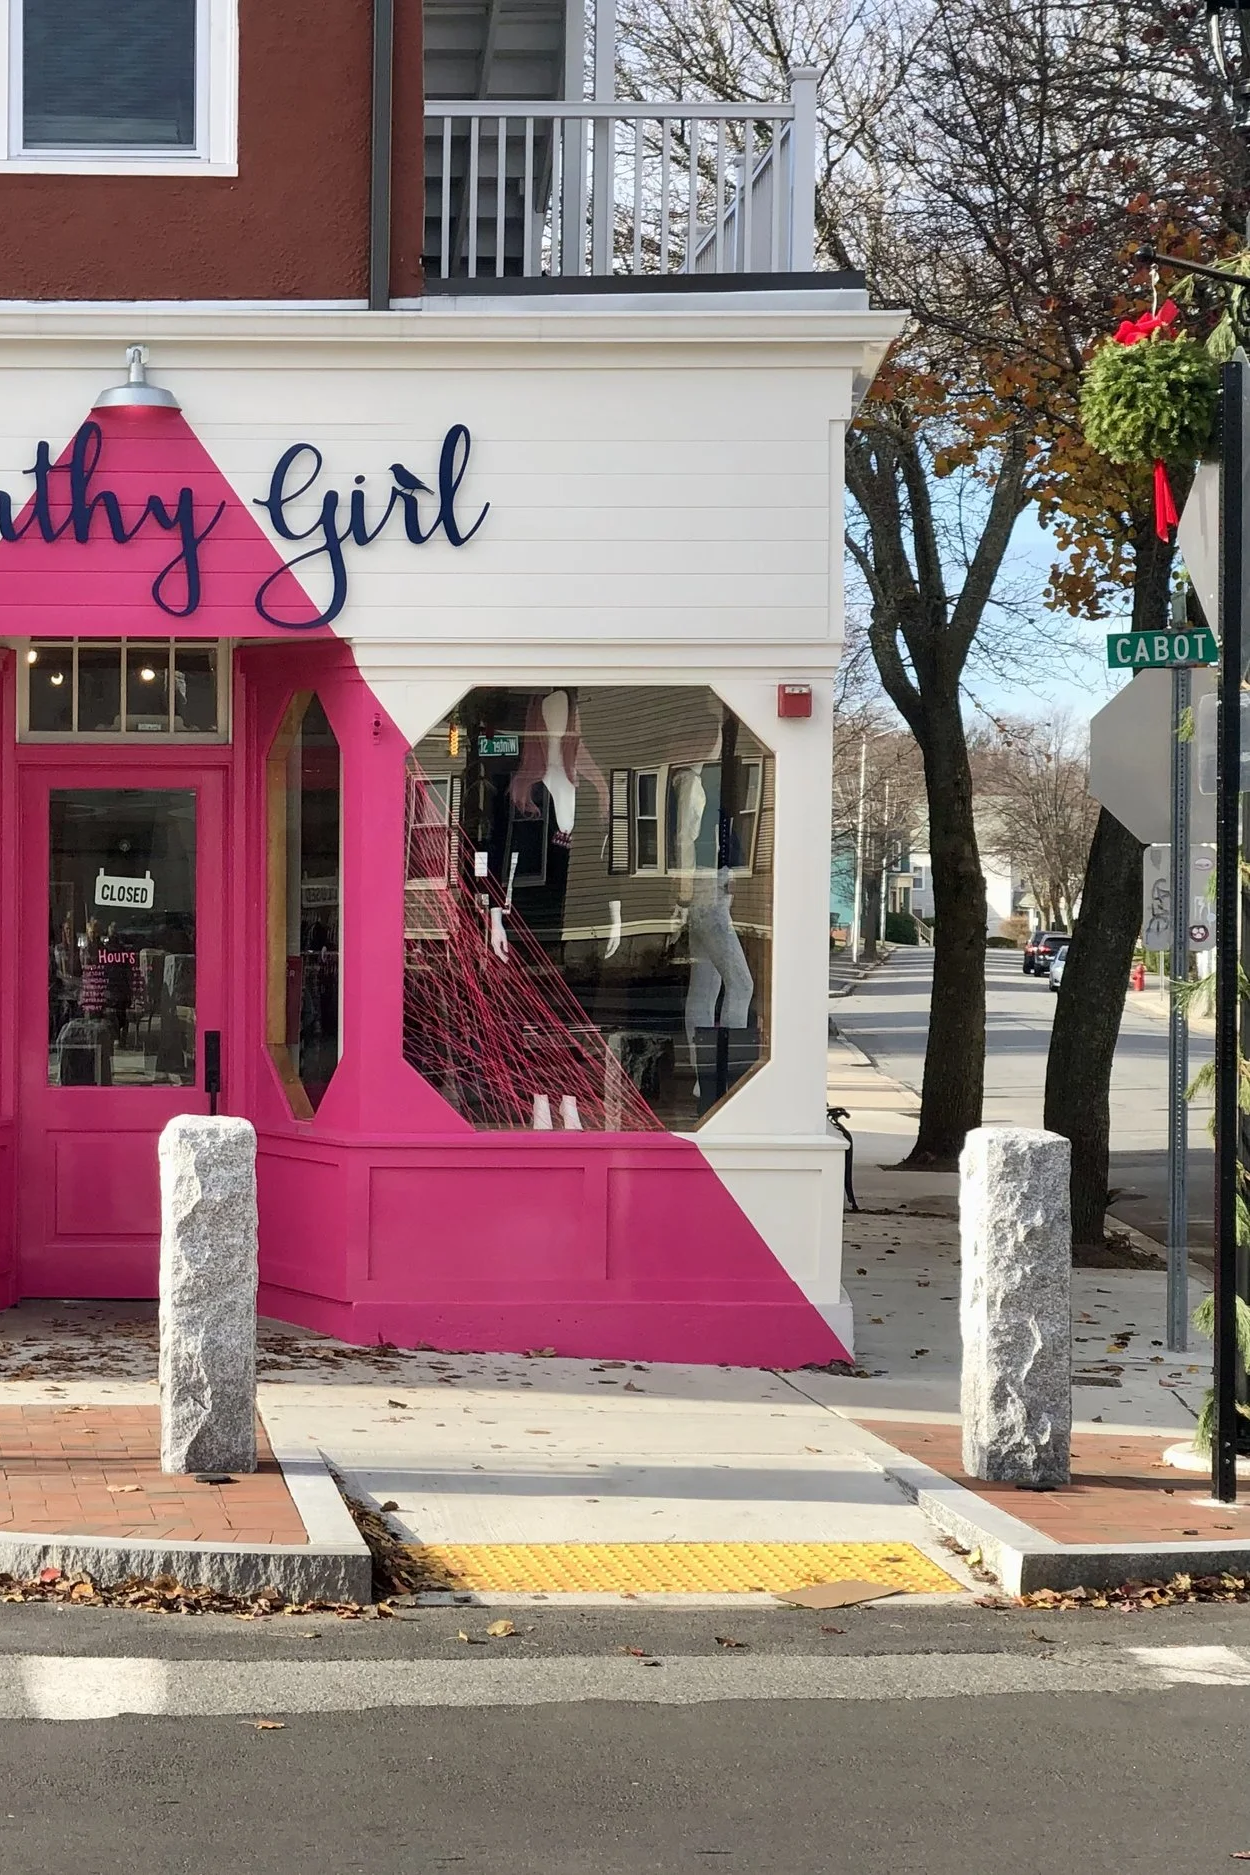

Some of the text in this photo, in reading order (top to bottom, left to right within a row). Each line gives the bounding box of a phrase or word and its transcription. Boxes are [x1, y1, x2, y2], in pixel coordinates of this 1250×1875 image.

[253, 423, 491, 630] Girl
[1116, 633, 1207, 663] CABOT
[101, 884, 148, 904] CLOSED
[98, 949, 136, 964] Hours
